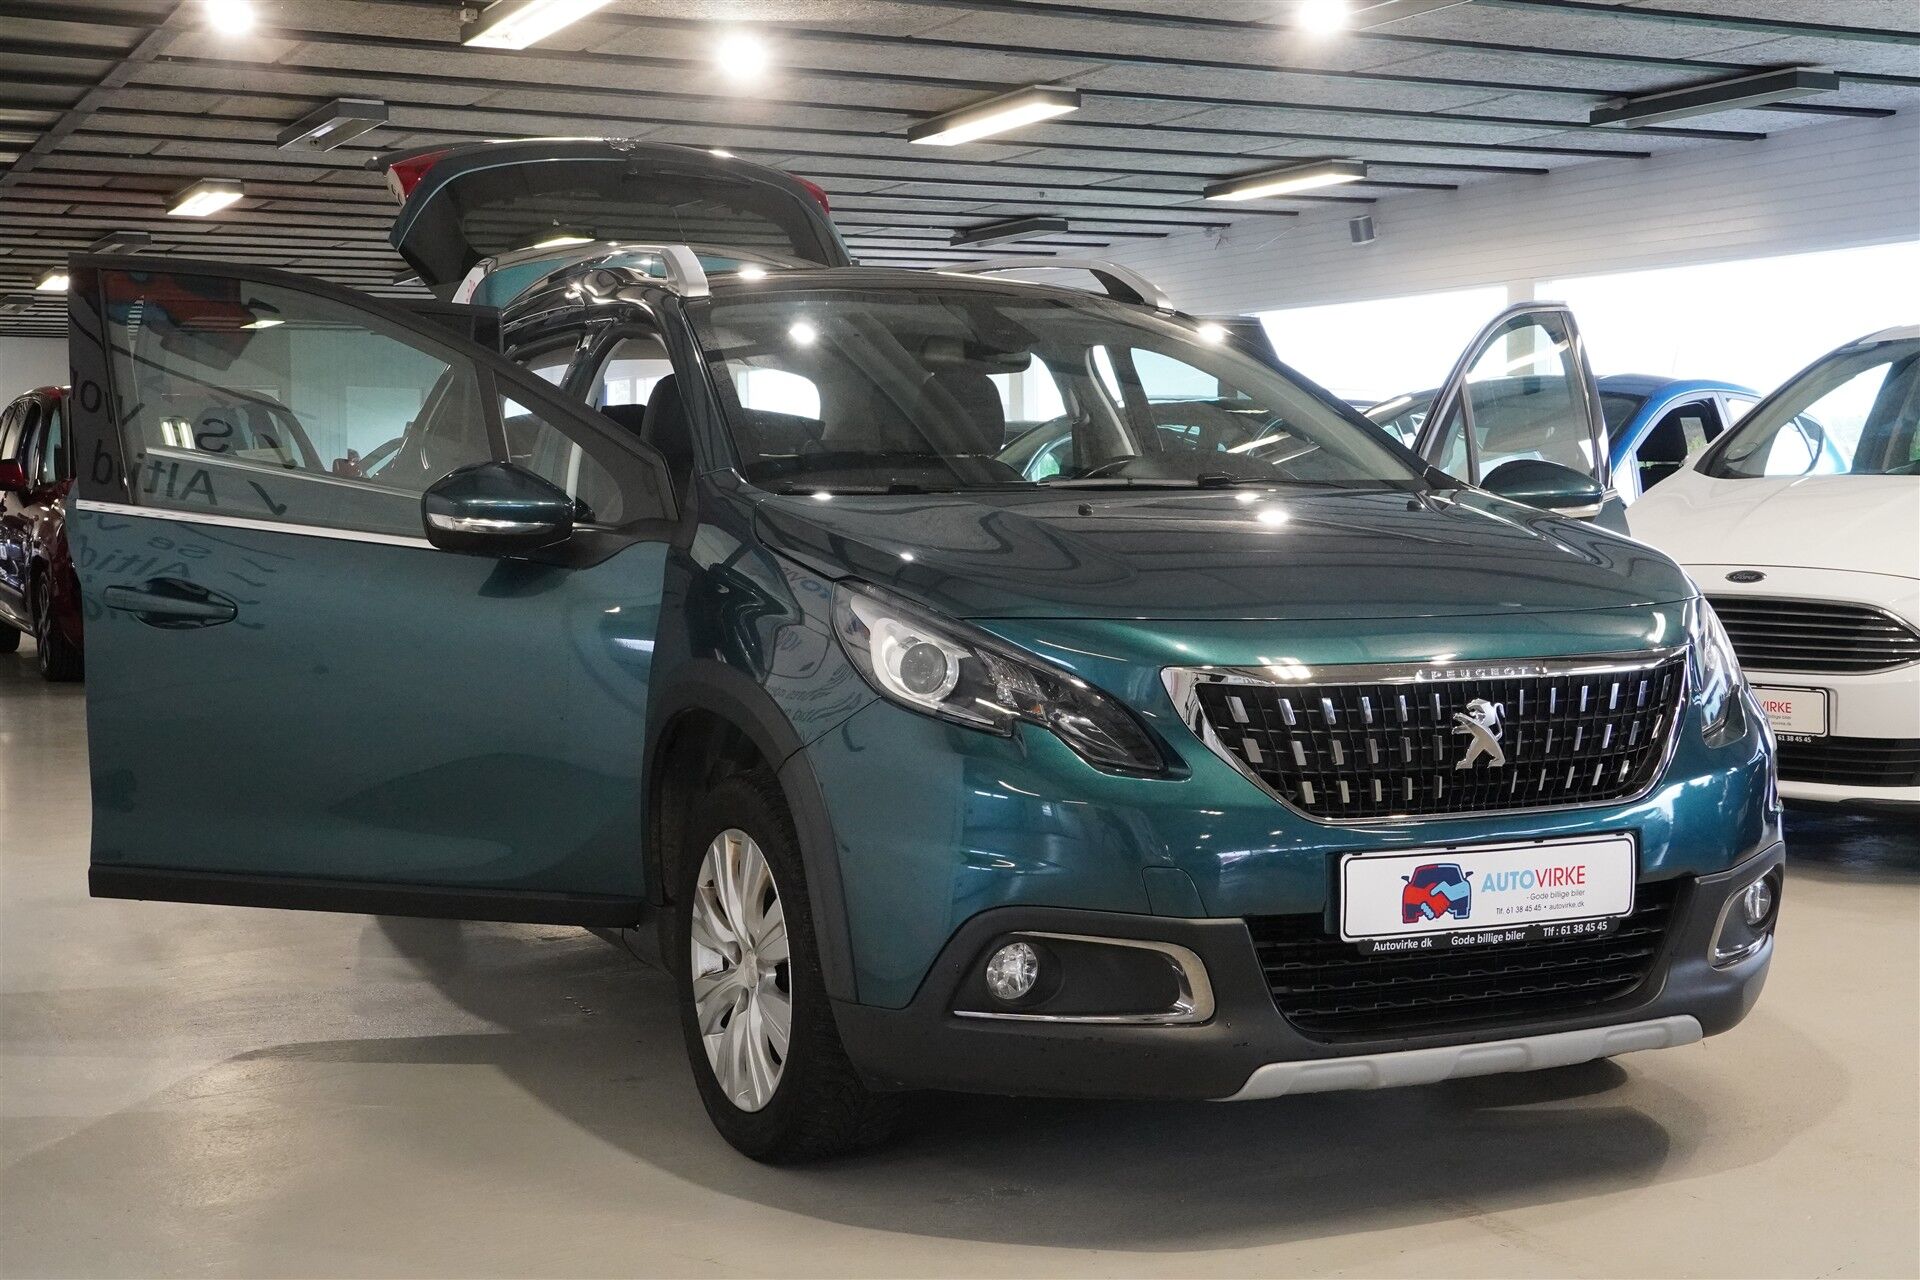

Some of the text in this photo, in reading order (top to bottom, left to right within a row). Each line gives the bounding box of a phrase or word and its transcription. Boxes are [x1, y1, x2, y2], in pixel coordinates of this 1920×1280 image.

[1431, 666, 1529, 680] PEUGEOT
[1481, 865, 1586, 893] AUTOVIRKE
[1530, 892, 1549, 901] Gode
[1550, 890, 1569, 900] billige
[1571, 889, 1585, 897] biler
[1505, 906, 1514, 914] 61
[1373, 940, 1419, 952] Autovirke
[1451, 934, 1476, 946] Gode
[1478, 932, 1503, 946] billige
[1505, 930, 1525, 942] biler
[1561, 924, 1572, 935] 61
[1573, 922, 1584, 933] 38
[1585, 922, 1596, 932] 45
[1597, 920, 1608, 931] 45
